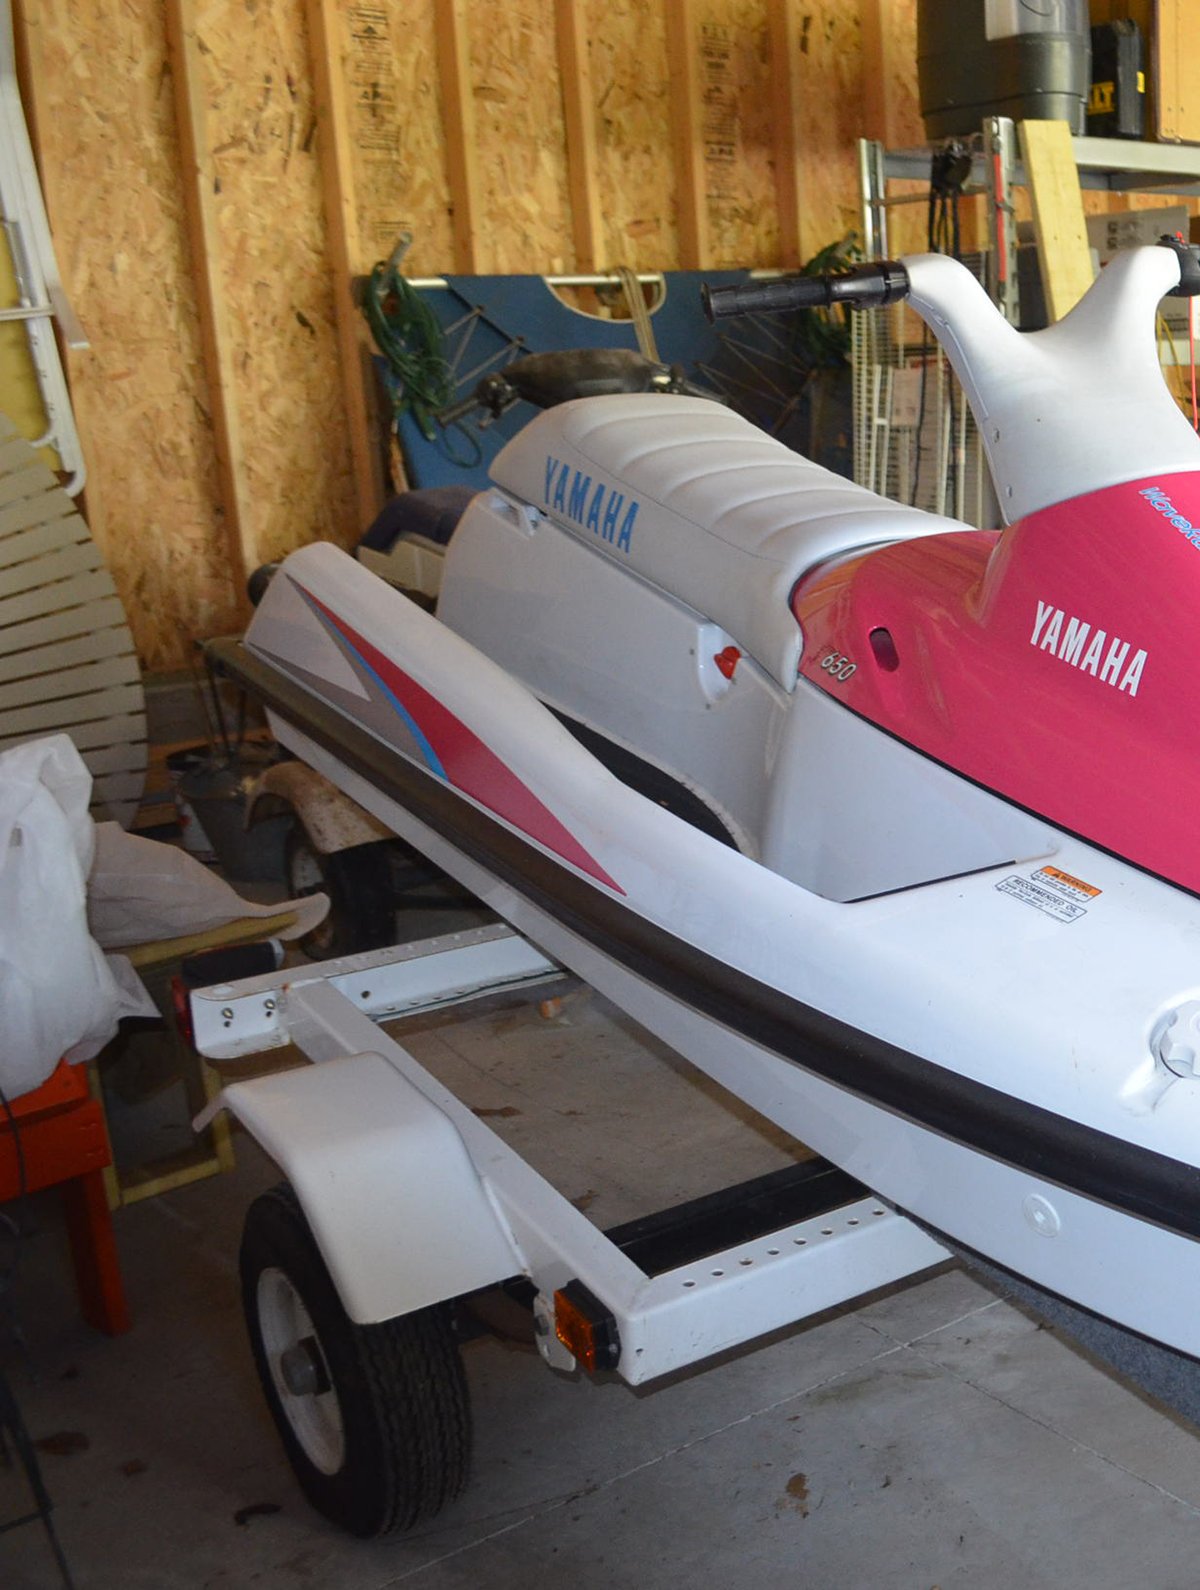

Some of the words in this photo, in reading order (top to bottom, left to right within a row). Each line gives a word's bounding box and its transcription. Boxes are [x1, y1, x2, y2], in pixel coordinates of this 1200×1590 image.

[544, 455, 640, 553] YAMAHA
[820, 652, 857, 682] 650
[1030, 600, 1148, 698] YAMAHA
[1013, 879, 1064, 907] RECOMMENDED
[1065, 904, 1078, 914] OIL
